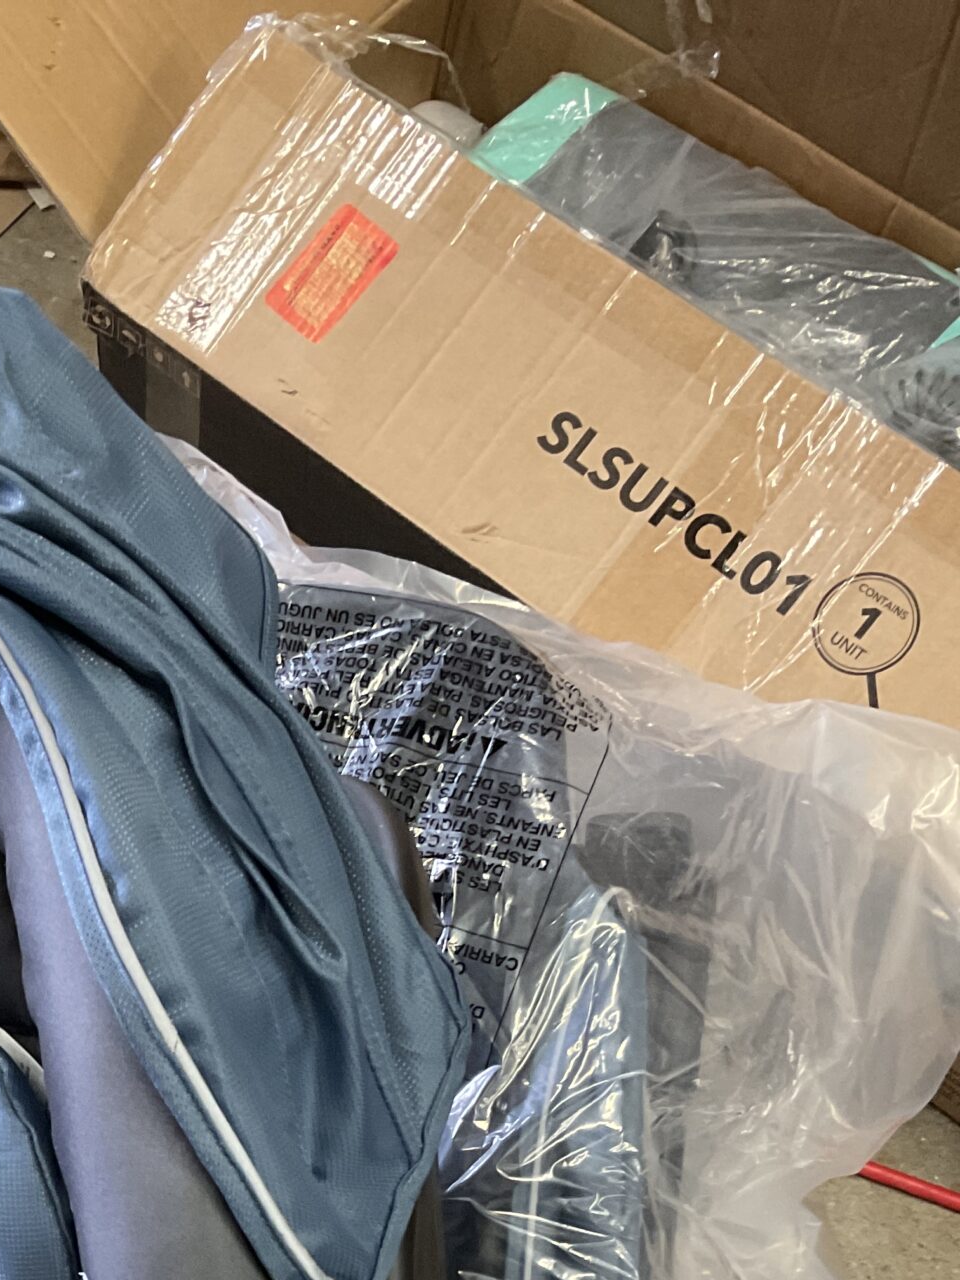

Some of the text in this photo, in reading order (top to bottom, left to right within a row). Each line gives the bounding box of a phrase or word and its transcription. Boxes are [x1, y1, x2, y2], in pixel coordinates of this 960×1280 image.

[537, 412, 814, 616] SLSUPCL01
[858, 583, 909, 621] CONTAINS
[326, 608, 350, 624] UN
[354, 612, 377, 628] ES
[854, 607, 882, 640] 1
[470, 630, 512, 649] ESTA
[830, 631, 867, 660] UNIT
[468, 646, 494, 662] EN
[440, 670, 534, 701] MANTENGA
[427, 700, 450, 718] DE
[528, 722, 562, 741] LAS
[401, 775, 431, 796] LES
[473, 775, 493, 790] DE
[477, 793, 510, 811] LES
[454, 805, 478, 819] NE
[517, 835, 541, 852] EN
